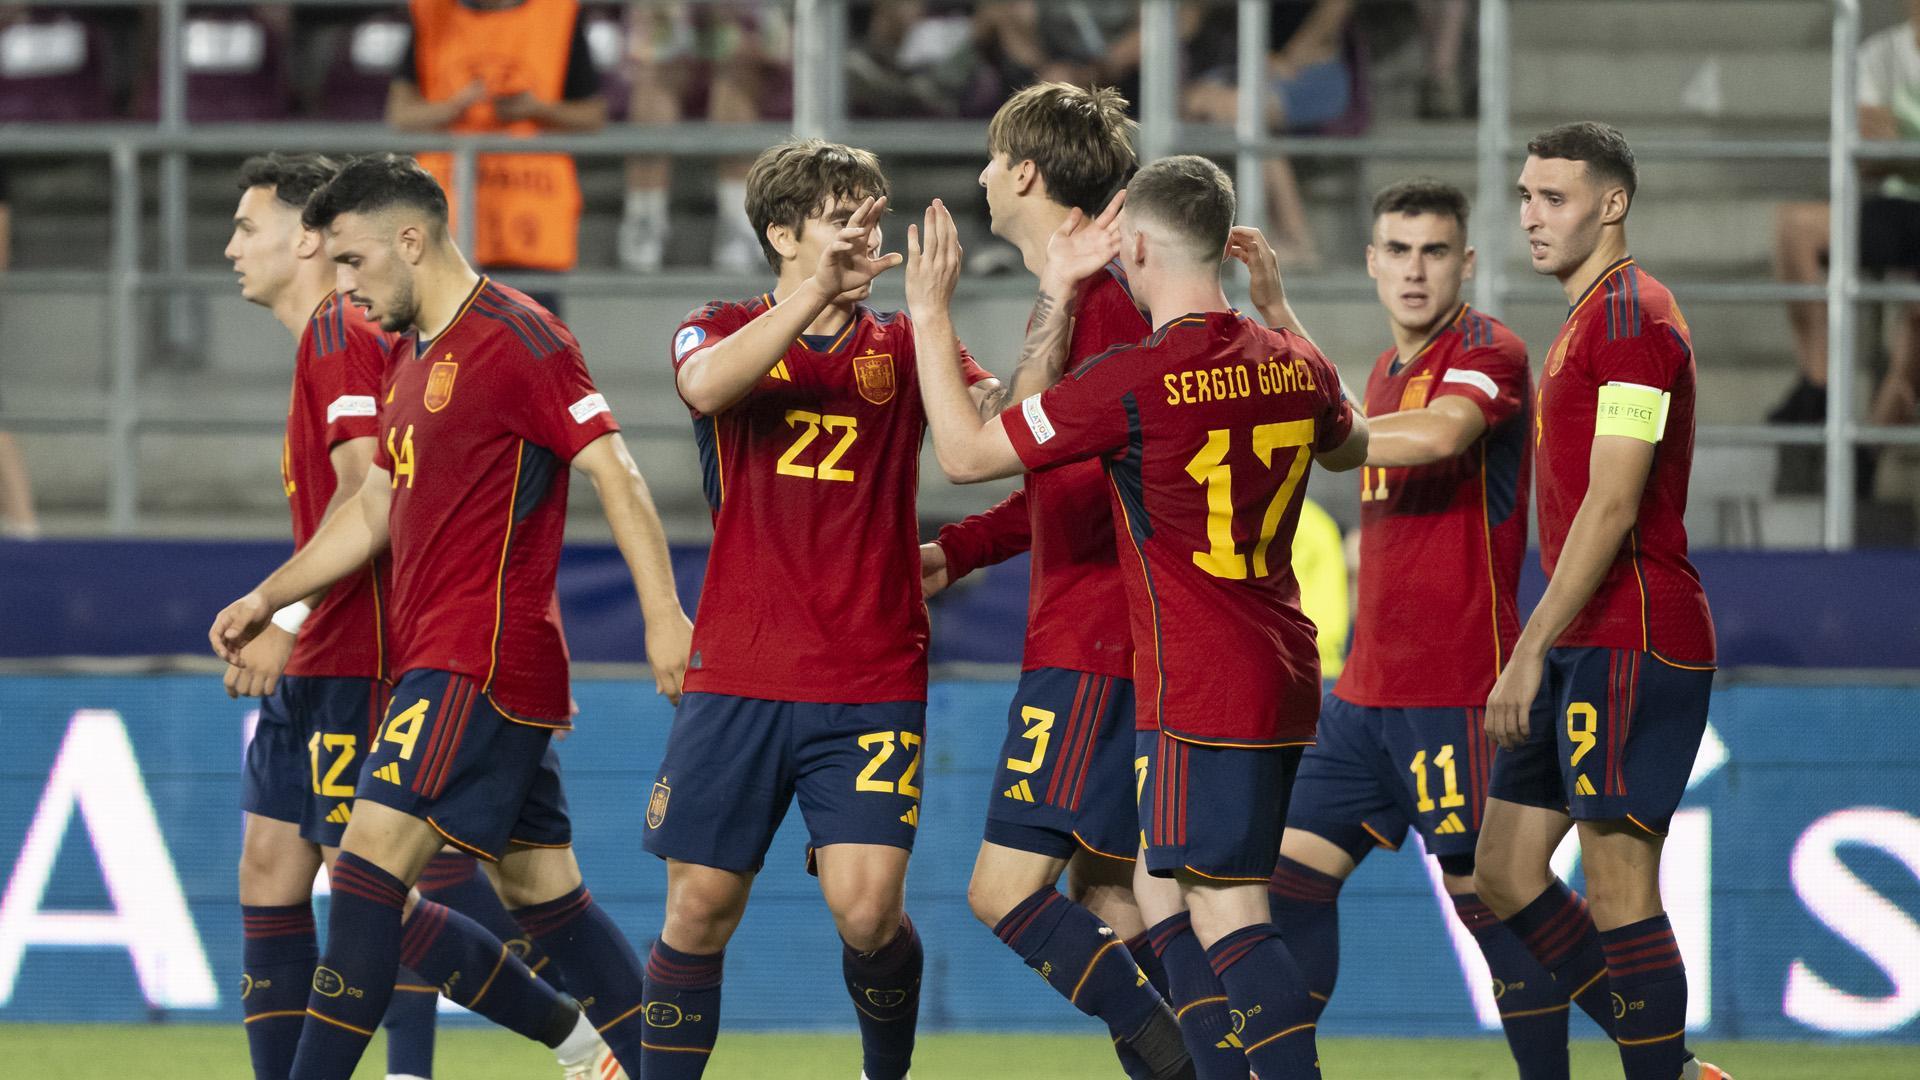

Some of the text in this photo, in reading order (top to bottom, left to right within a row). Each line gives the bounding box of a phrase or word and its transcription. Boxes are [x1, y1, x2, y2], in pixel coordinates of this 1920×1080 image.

[1163, 356, 1316, 406] SERGIO GÓMEZ
[1607, 405, 1653, 421] REPECT
[387, 424, 415, 489] 14
[776, 409, 858, 482] 22
[1184, 418, 1315, 580] 17
[308, 731, 357, 797] 12
[855, 731, 922, 799] 22
[1006, 705, 1056, 774] 3
[1566, 702, 1598, 767] 9
[1409, 744, 1465, 813] 11
[685, 1014, 703, 1022] 09
[1246, 1004, 1263, 1018] 09
[1628, 1000, 1646, 1011] 09
